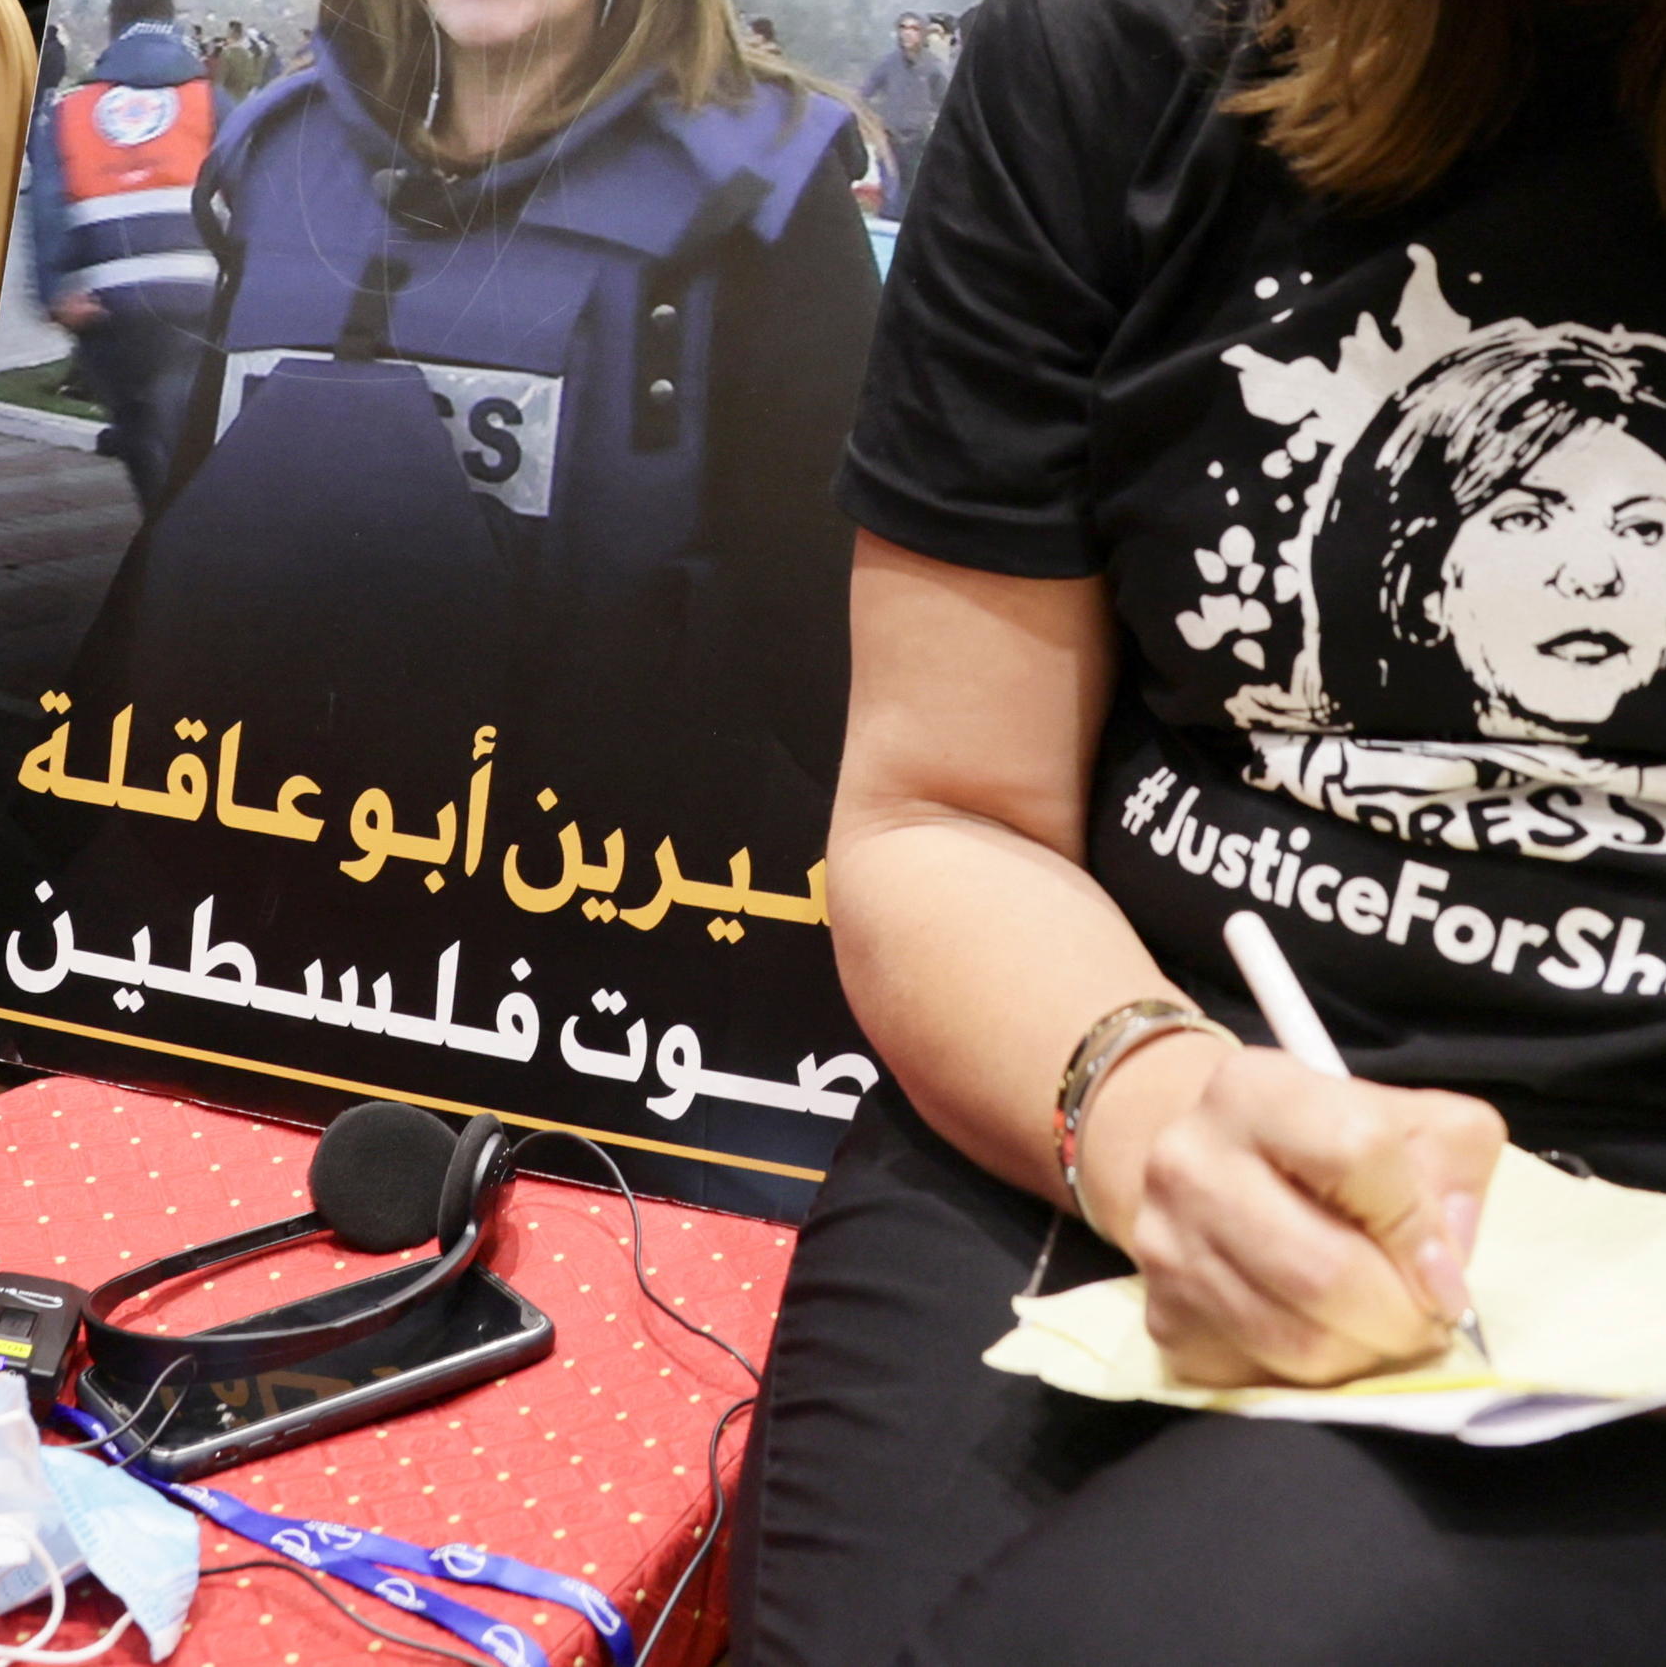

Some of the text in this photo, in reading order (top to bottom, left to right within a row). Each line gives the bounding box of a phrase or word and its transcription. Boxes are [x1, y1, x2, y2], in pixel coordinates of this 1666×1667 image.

[17, 689, 325, 842] عاقلة
[339, 725, 497, 895] أبو
[5, 880, 880, 1121] صوت فلسطين
